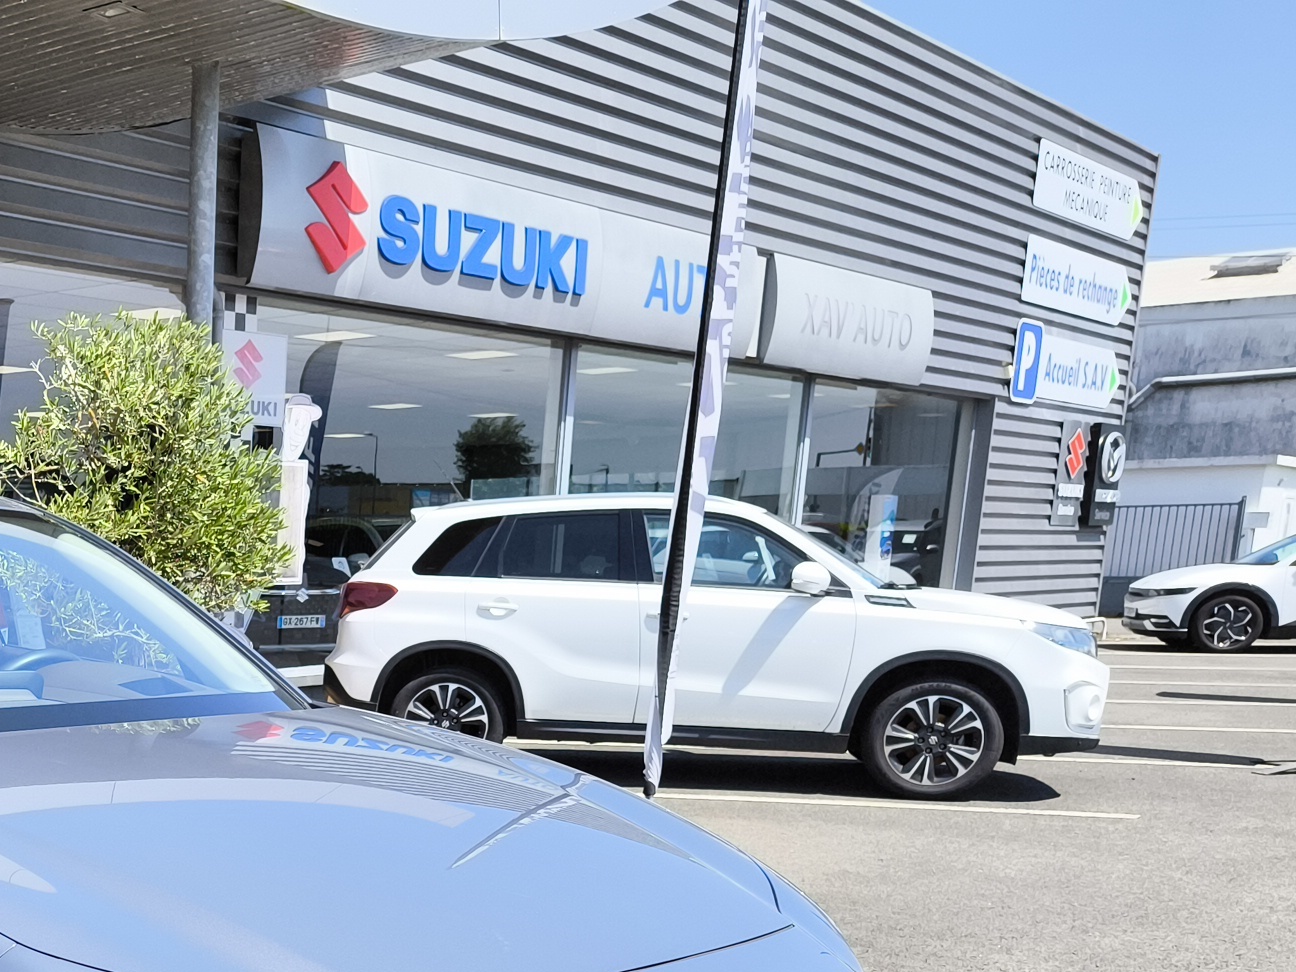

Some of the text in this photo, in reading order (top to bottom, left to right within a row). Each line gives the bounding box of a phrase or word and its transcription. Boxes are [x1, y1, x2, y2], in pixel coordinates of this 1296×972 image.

[1044, 150, 1132, 205] CARROSSERIE PEINTURE
[1063, 189, 1109, 222] MECANIQUE
[377, 194, 589, 296] SUZUKI
[644, 255, 707, 316] AU
[1029, 253, 1119, 314] Pièces de rechange
[1017, 330, 1037, 392] P
[1044, 353, 1082, 388] Accueil
